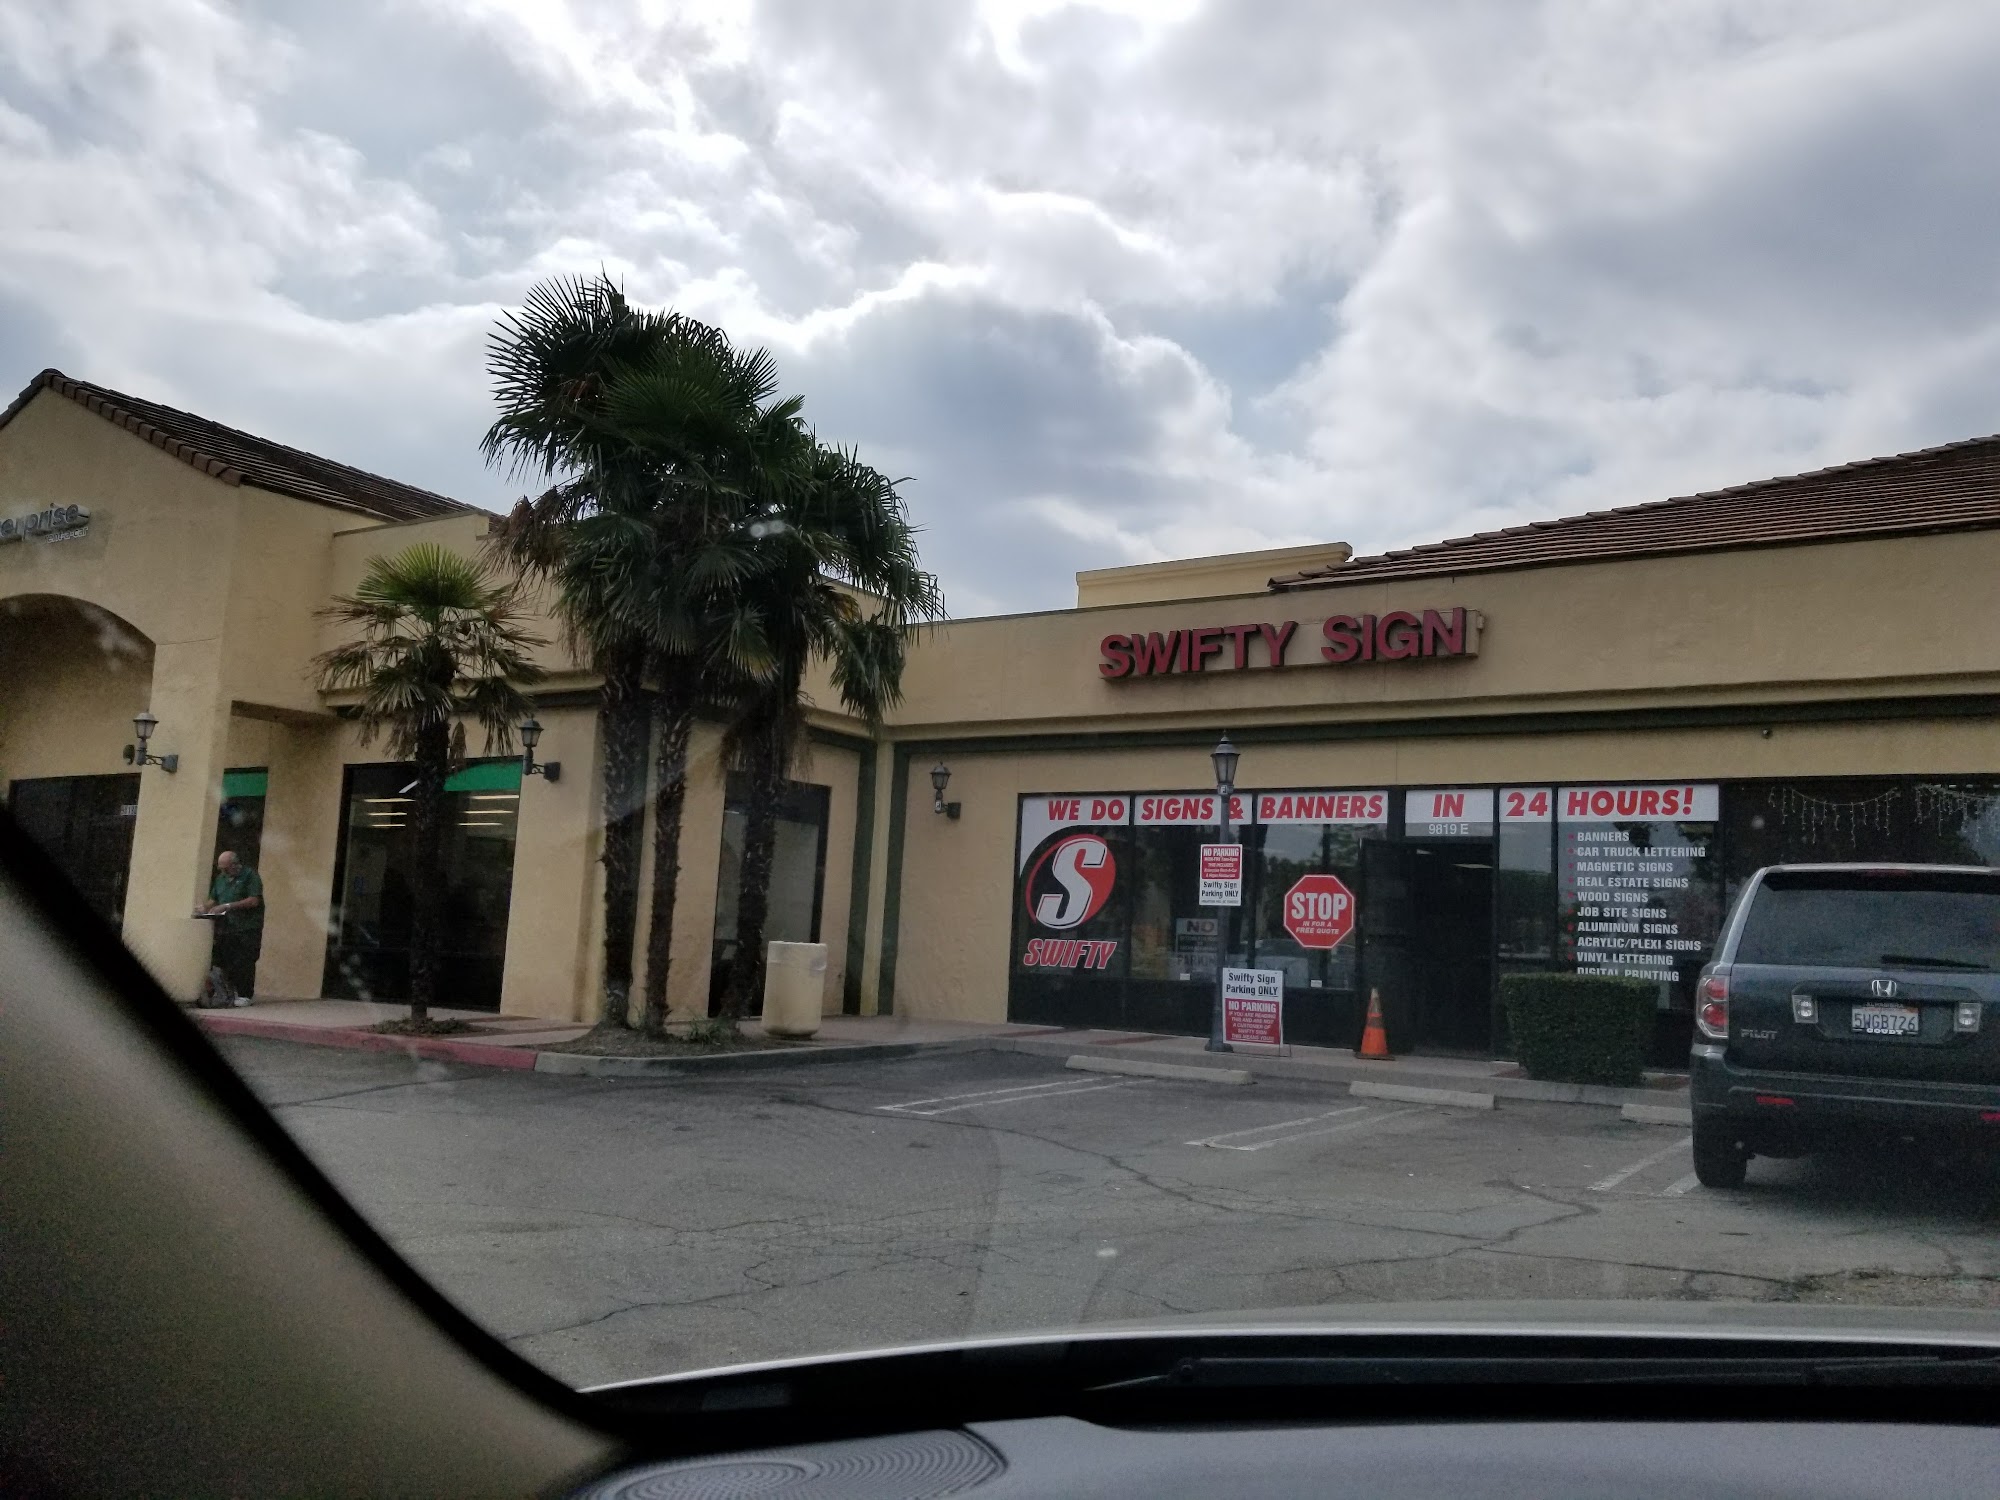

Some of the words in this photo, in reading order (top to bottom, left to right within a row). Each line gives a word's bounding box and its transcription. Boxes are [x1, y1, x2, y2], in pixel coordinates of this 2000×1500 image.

[0, 502, 79, 541] erprise
[1099, 620, 1298, 678] SWIFTY
[1321, 607, 1467, 662] SIGN
[1048, 800, 1081, 820] WE
[1090, 799, 1124, 820] DO
[1141, 797, 1214, 820] SIGNS
[1229, 797, 1244, 820] &
[1260, 794, 1384, 819] BANNERS
[1432, 793, 1465, 818] IN
[1506, 791, 1548, 817] 24
[1567, 787, 1694, 816] HOURS!
[1428, 823, 1457, 835] 9819
[1460, 824, 1469, 835] E
[1577, 831, 1630, 842] BANNERS
[1203, 847, 1212, 857] NO
[1213, 847, 1240, 857] PARKING
[1577, 847, 1599, 857] CAR
[1603, 847, 1641, 857] TRUCK
[1644, 847, 1706, 857] LETTERING
[1577, 861, 1634, 872] MAGNETIC
[1638, 862, 1673, 872] SIGNS
[1036, 838, 1107, 930] S
[1203, 881, 1223, 889] Swifty
[1224, 881, 1238, 889] Sign
[1577, 877, 1604, 887] REAL
[1608, 877, 1650, 887] ESTATE
[1653, 878, 1689, 888] SIGNS
[1201, 890, 1223, 899] Parking
[1577, 891, 1610, 902] WOOD
[1613, 892, 1649, 903] SIGNS
[1291, 892, 1348, 920] STOP
[1577, 907, 1599, 917] JOB
[1603, 907, 1628, 917] SITE
[1631, 908, 1667, 919] SIGNS
[1577, 922, 1639, 933] ALUMINUM
[1642, 924, 1679, 935] SIGNS
[1577, 937, 1662, 949] ACRYLIC/PLEXI
[1665, 940, 1701, 951] SIGNS
[1023, 938, 1117, 970] SWIFTY
[1576, 952, 1609, 962] VINYL
[1612, 953, 1674, 965] LETTERING
[1228, 972, 1255, 984] Swifty
[1257, 973, 1276, 985] Sign
[1624, 969, 1680, 982] PRINTING
[1226, 984, 1256, 996] Parking
[1258, 986, 1279, 996] ONLY
[1228, 1000, 1240, 1010] NO
[1241, 1001, 1277, 1013] PARKING
[1854, 1012, 1916, 1031] 5WGB726
